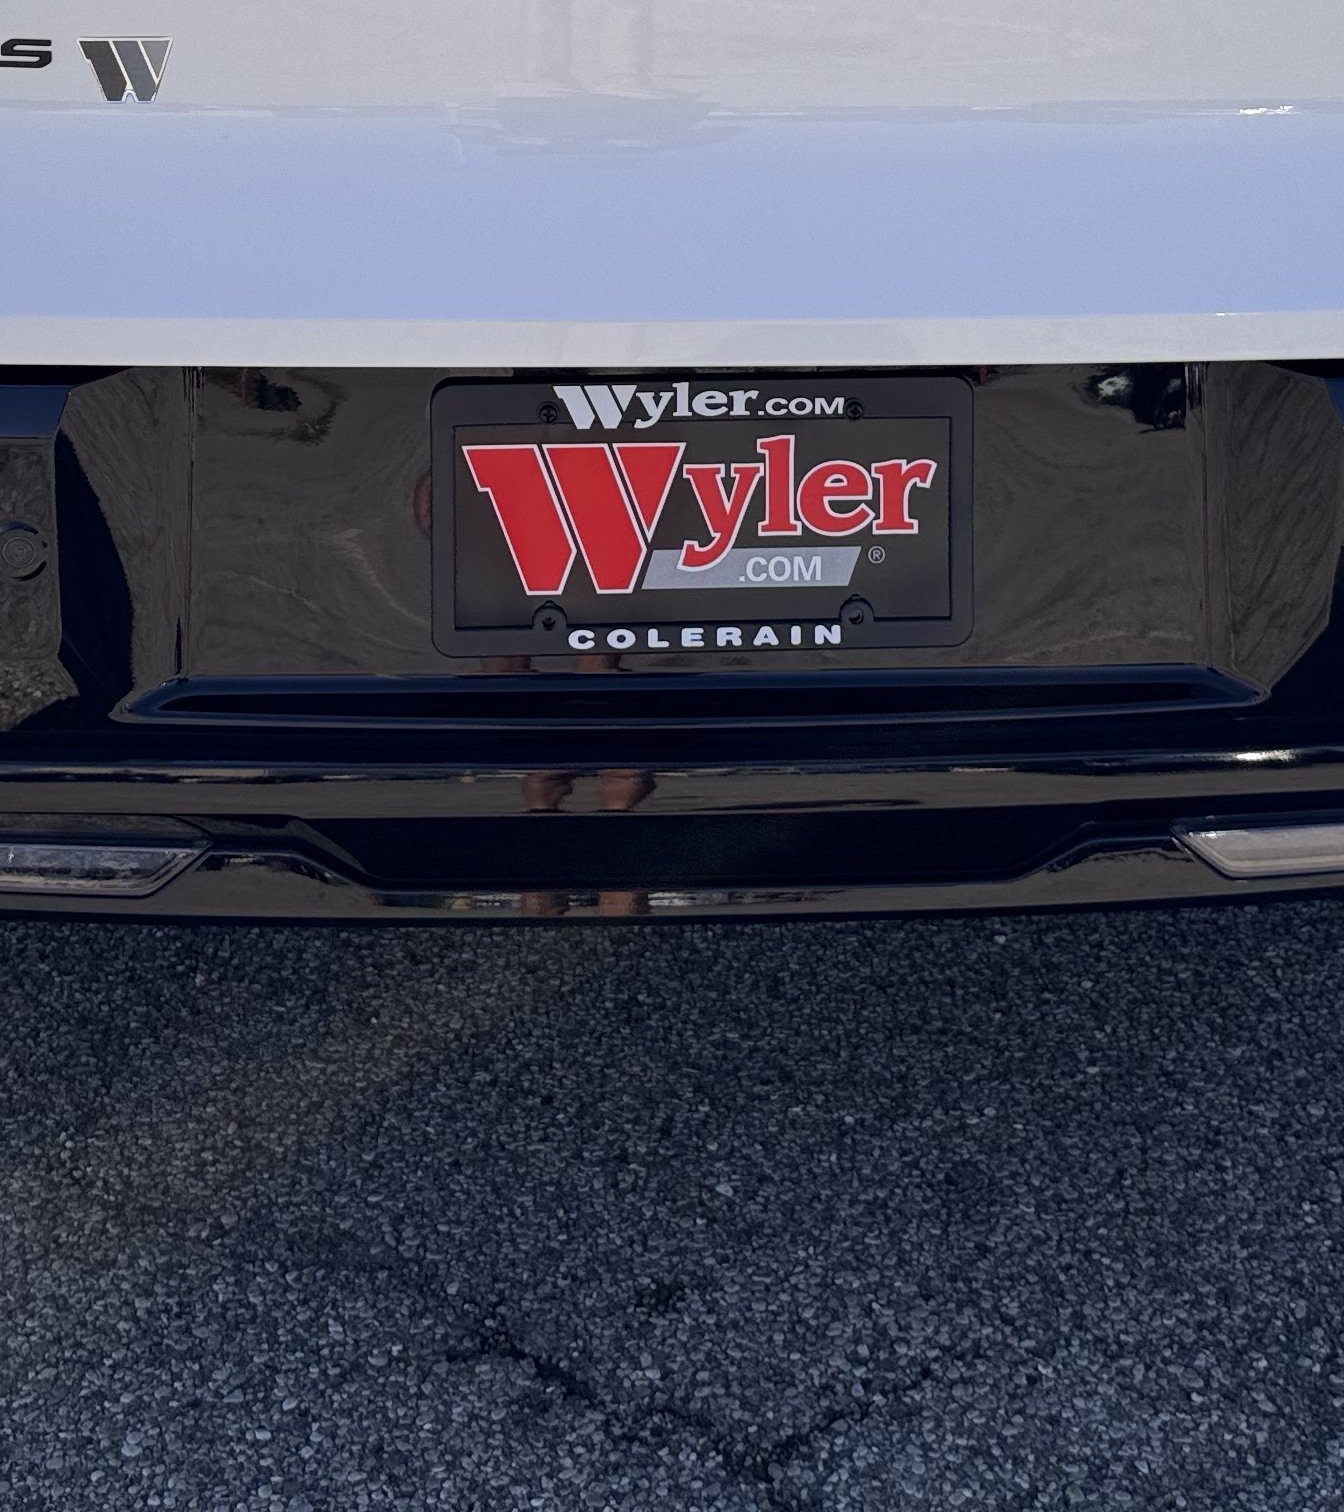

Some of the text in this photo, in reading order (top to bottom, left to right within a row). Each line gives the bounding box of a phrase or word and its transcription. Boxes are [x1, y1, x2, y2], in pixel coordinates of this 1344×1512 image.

[461, 434, 938, 596] Wyler
[737, 554, 823, 583] .COM
[567, 624, 842, 651] COLERAIN
